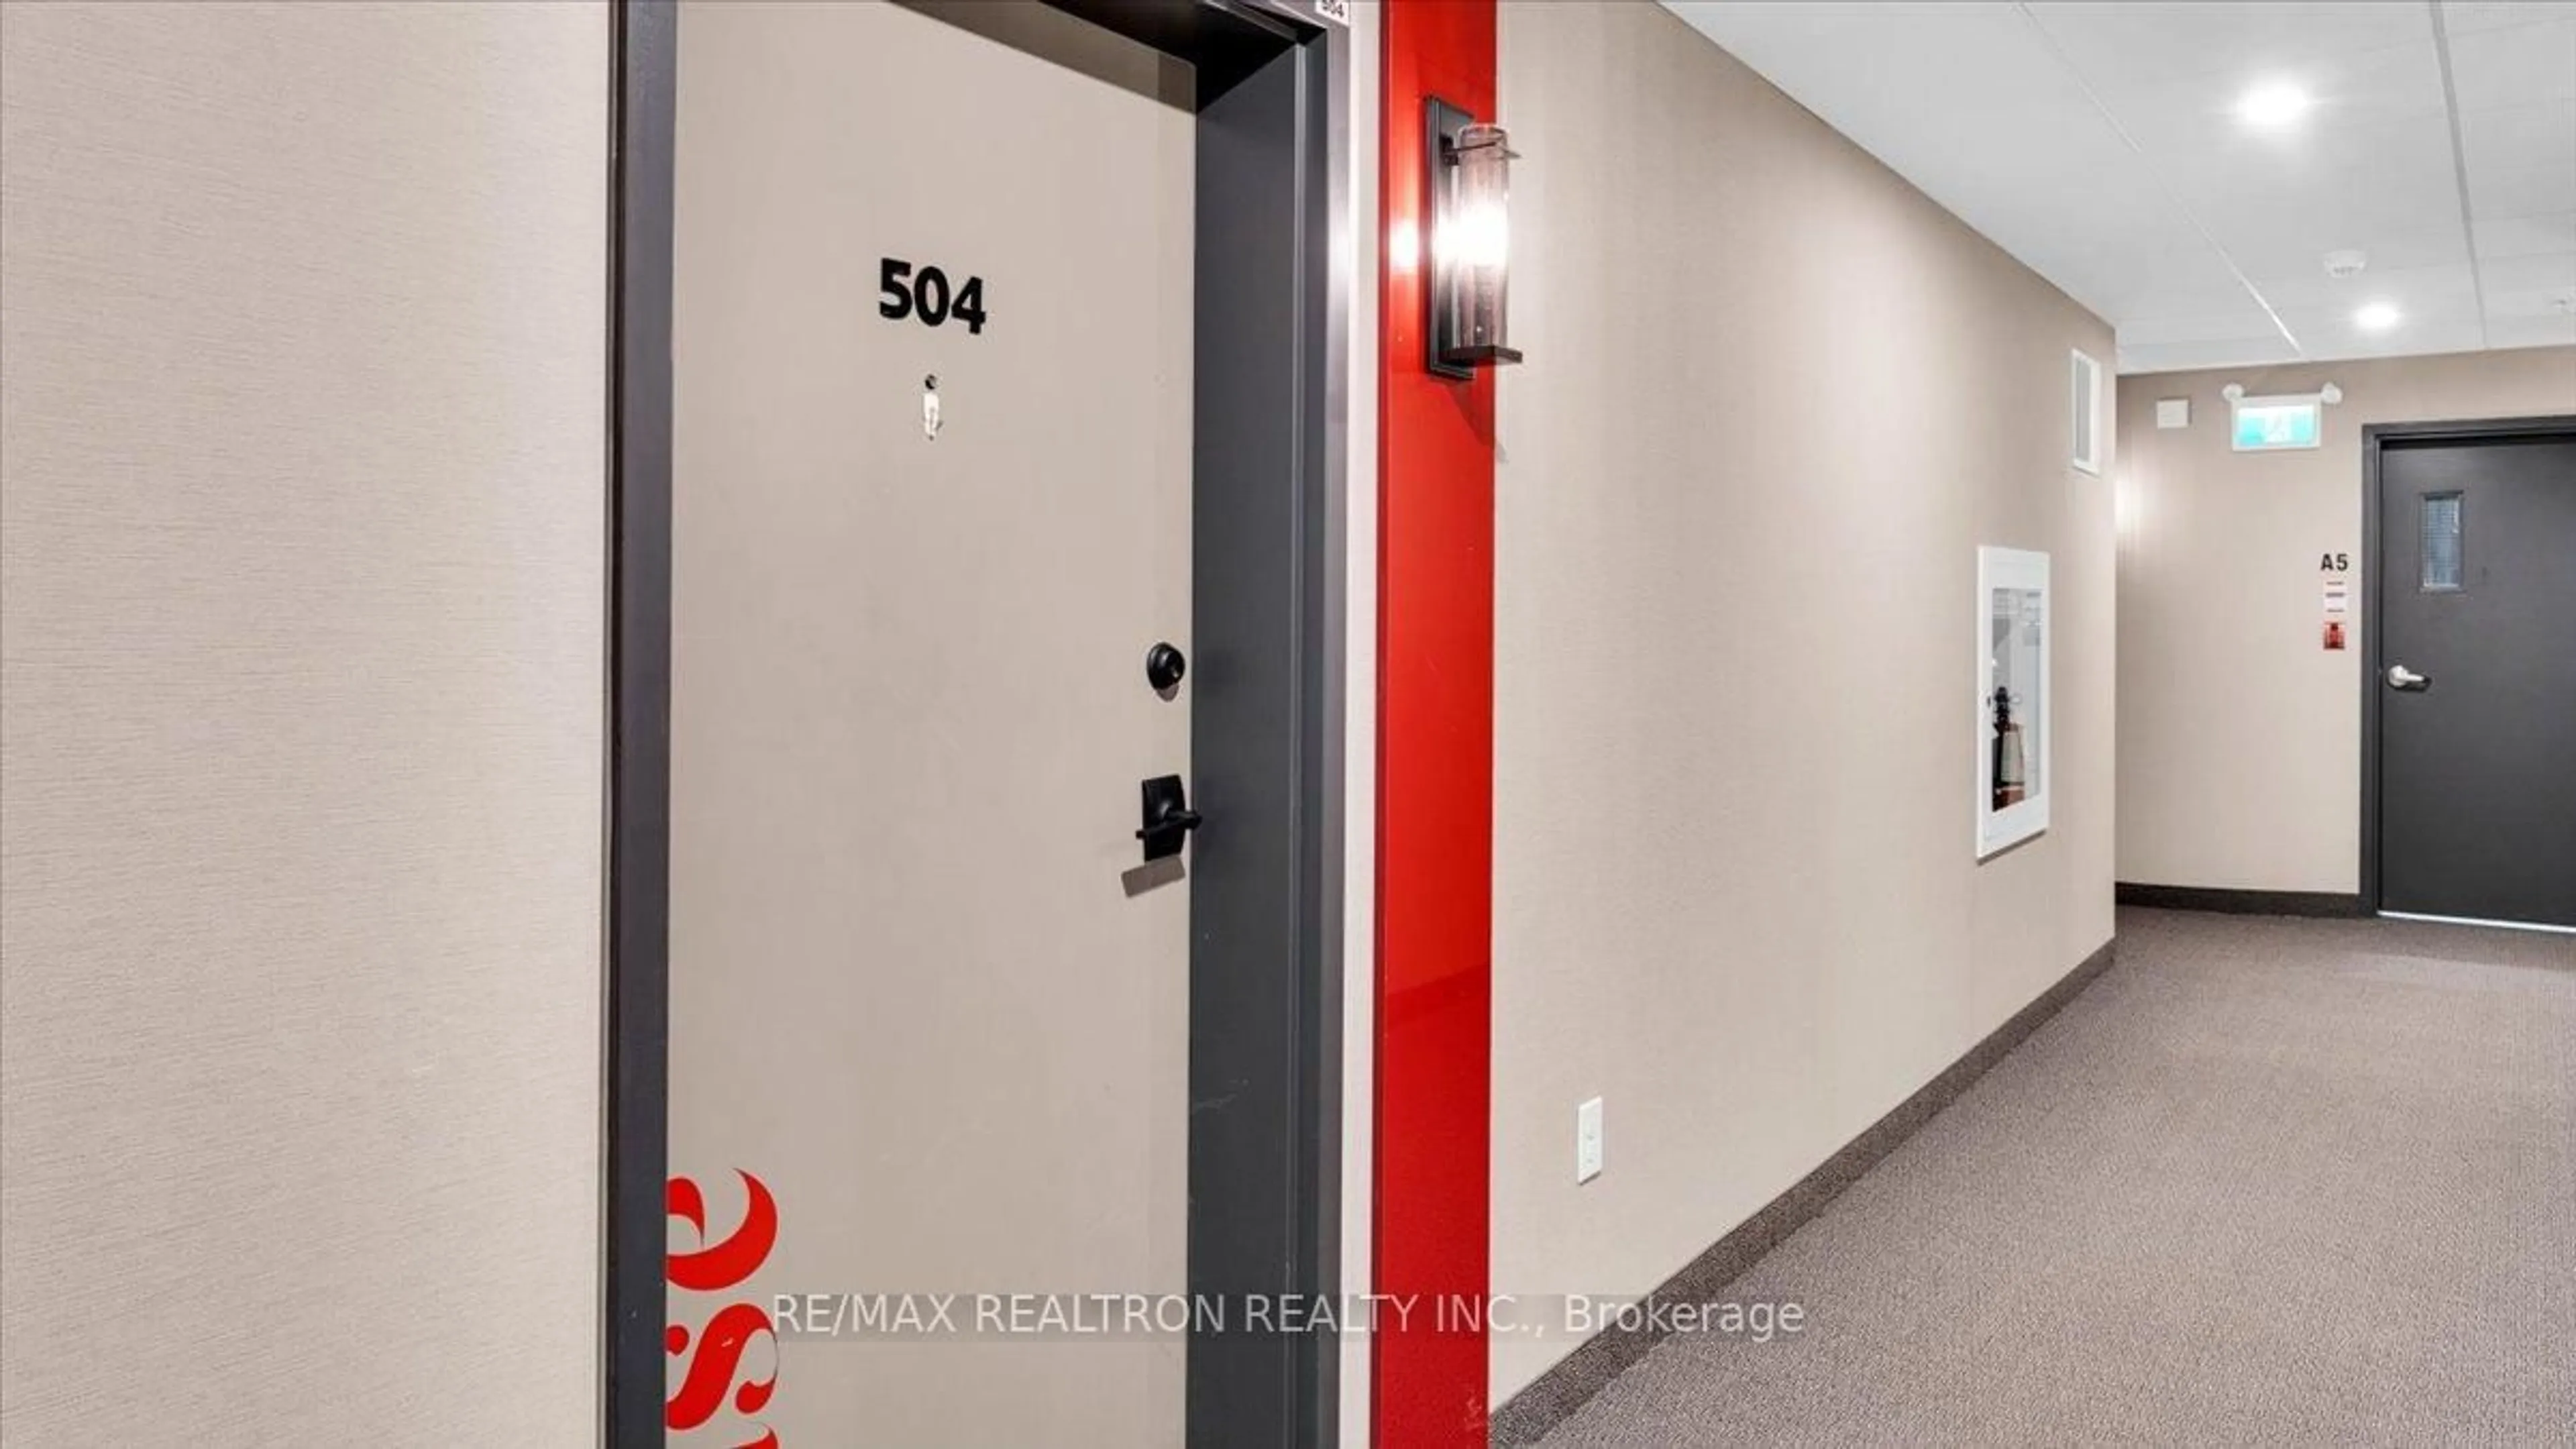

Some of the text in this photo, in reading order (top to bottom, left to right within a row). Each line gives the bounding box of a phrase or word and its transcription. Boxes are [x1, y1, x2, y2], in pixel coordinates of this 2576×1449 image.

[879, 258, 986, 335] 504
[2321, 553, 2348, 571] A5
[665, 1168, 778, 1449] se
